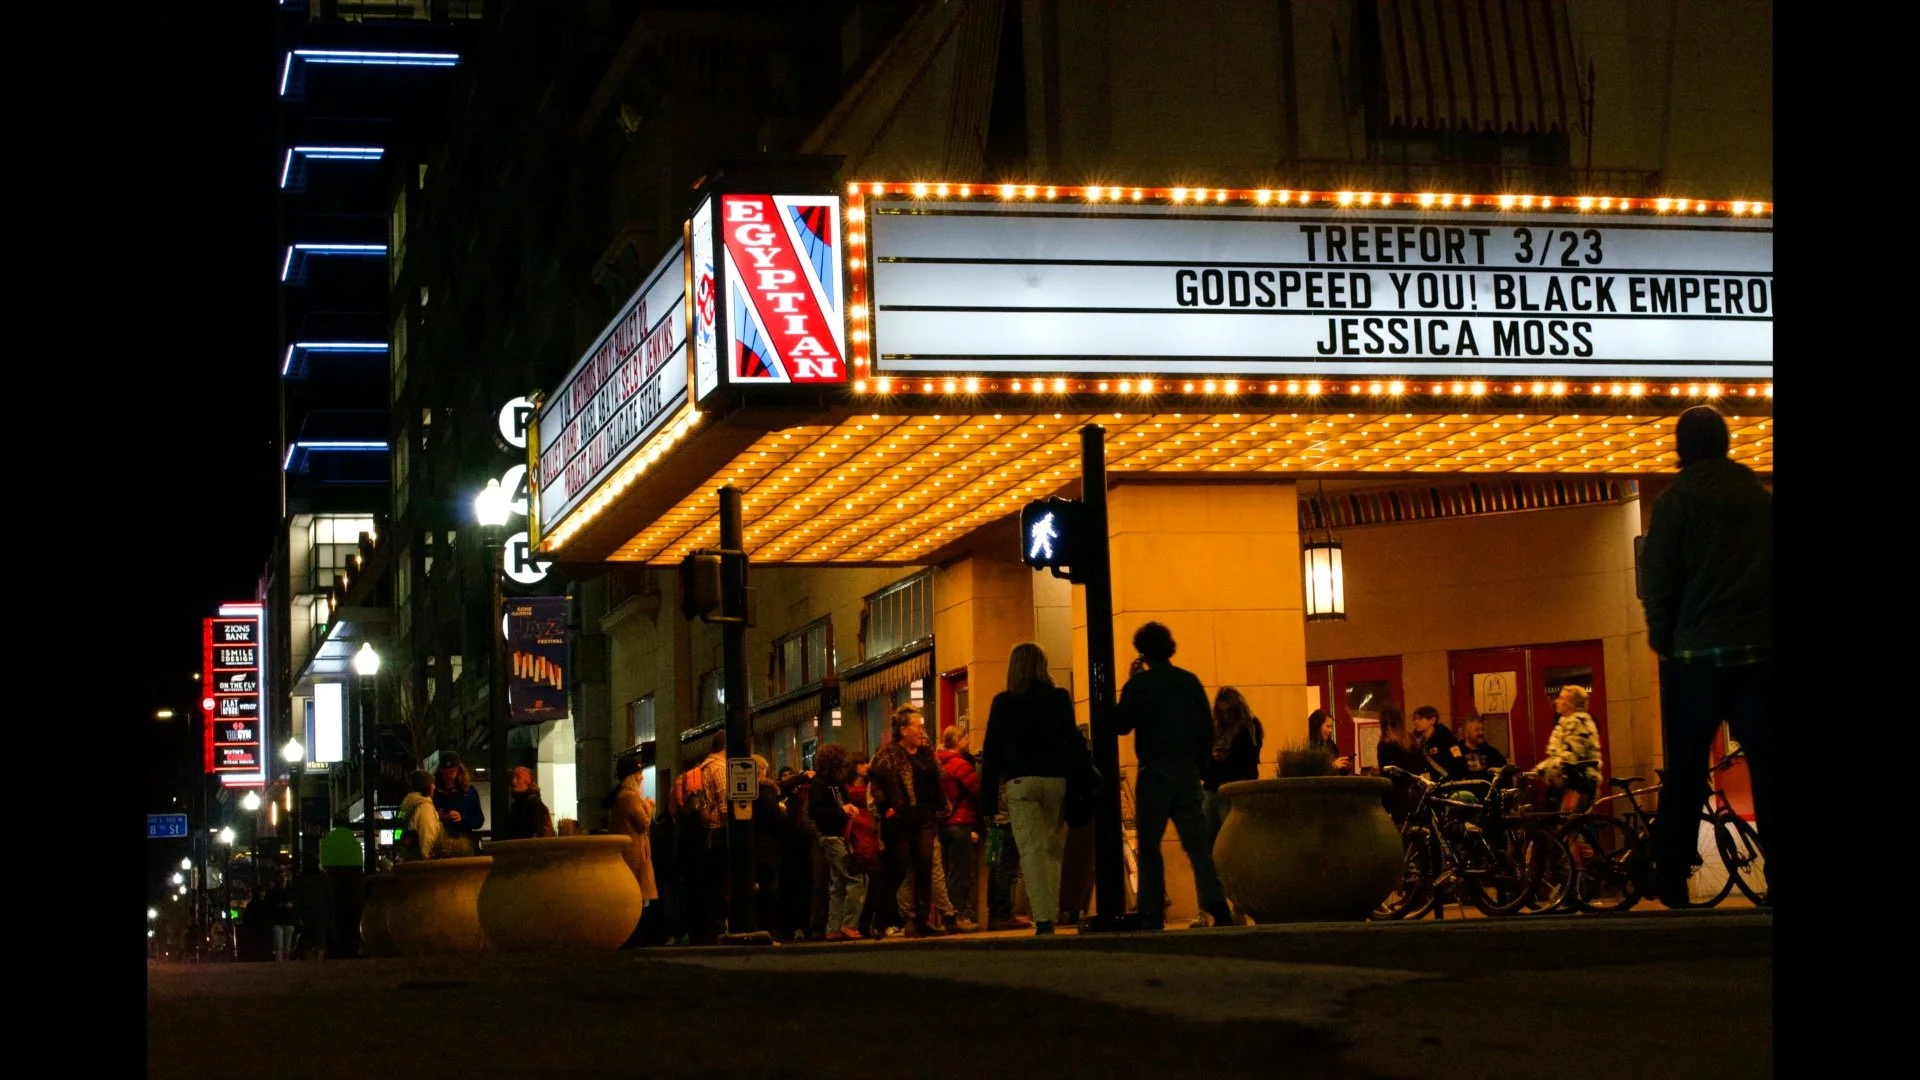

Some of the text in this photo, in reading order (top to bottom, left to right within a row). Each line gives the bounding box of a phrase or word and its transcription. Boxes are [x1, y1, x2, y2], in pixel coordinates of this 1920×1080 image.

[1300, 224, 1603, 267] TREEFORT 3/23
[726, 200, 839, 379] EGYPTIAN
[1175, 268, 1773, 314] GODSPEED YOU! BLACK EMPERO
[1316, 317, 1593, 357] JESSICA MOSS
[573, 361, 597, 413] METHODS
[615, 312, 638, 365] BALLET
[542, 441, 561, 486] BALLET
[580, 400, 597, 446] ANGEL
[622, 349, 644, 400] SELBY
[645, 315, 674, 377] JENKINS
[565, 450, 587, 497] PROJECT
[606, 399, 637, 460] DELICATE
[640, 374, 662, 426] STEVE
[224, 624, 251, 633] ZIONS
[225, 632, 249, 641] BANK
[225, 649, 254, 657] SMILE
[244, 681, 256, 689] FLY
